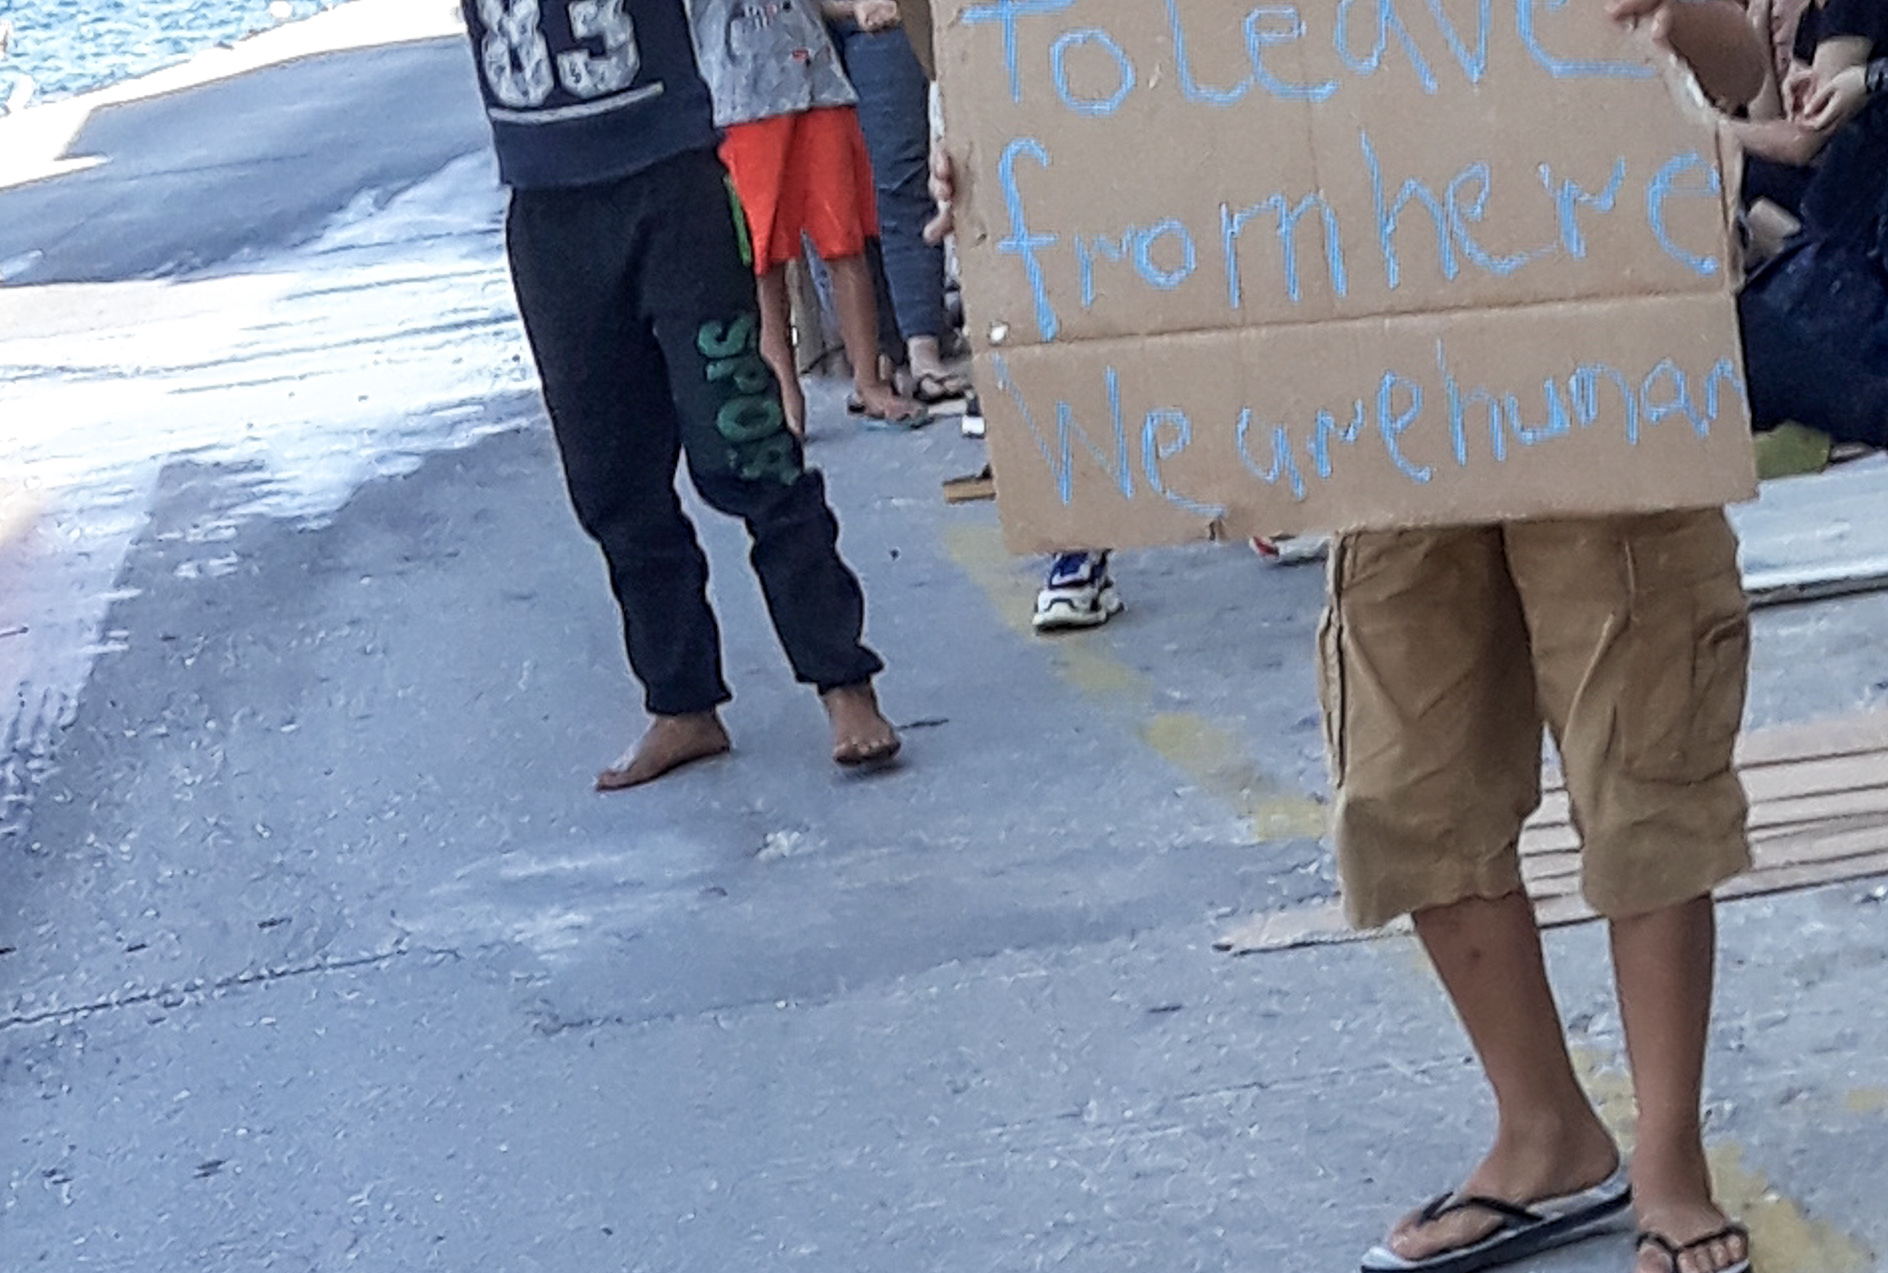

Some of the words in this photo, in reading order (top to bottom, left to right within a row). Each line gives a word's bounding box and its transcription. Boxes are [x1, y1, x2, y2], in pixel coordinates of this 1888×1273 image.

[996, 136, 1350, 342] from
[1359, 128, 1722, 290] here
[992, 352, 1228, 518] We
[1235, 370, 1433, 502] are
[1435, 338, 1750, 468] human
